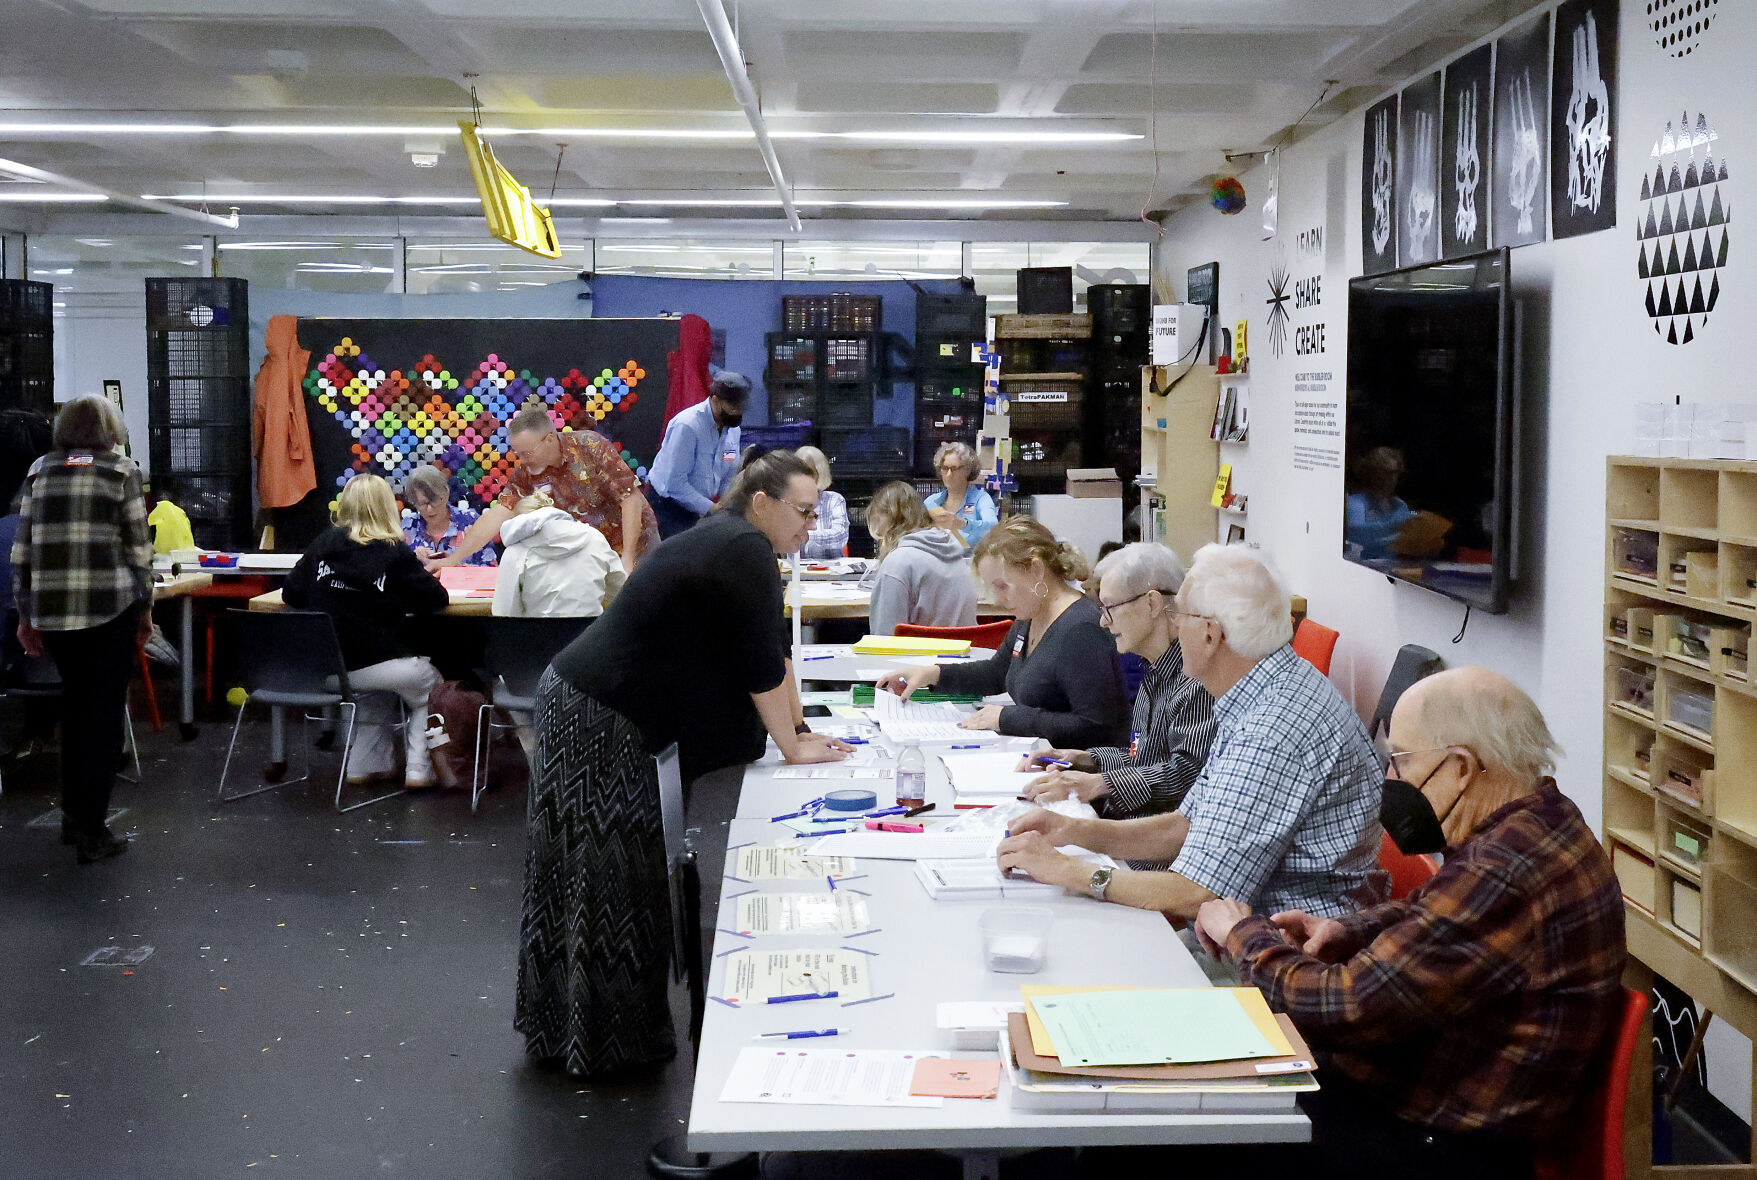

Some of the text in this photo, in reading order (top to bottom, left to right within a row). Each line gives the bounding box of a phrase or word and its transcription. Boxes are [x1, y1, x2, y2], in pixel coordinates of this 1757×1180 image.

[1295, 274, 1322, 310] SHARE
[1155, 327, 1176, 336] FUTURE
[1295, 323, 1326, 356] CREATE
